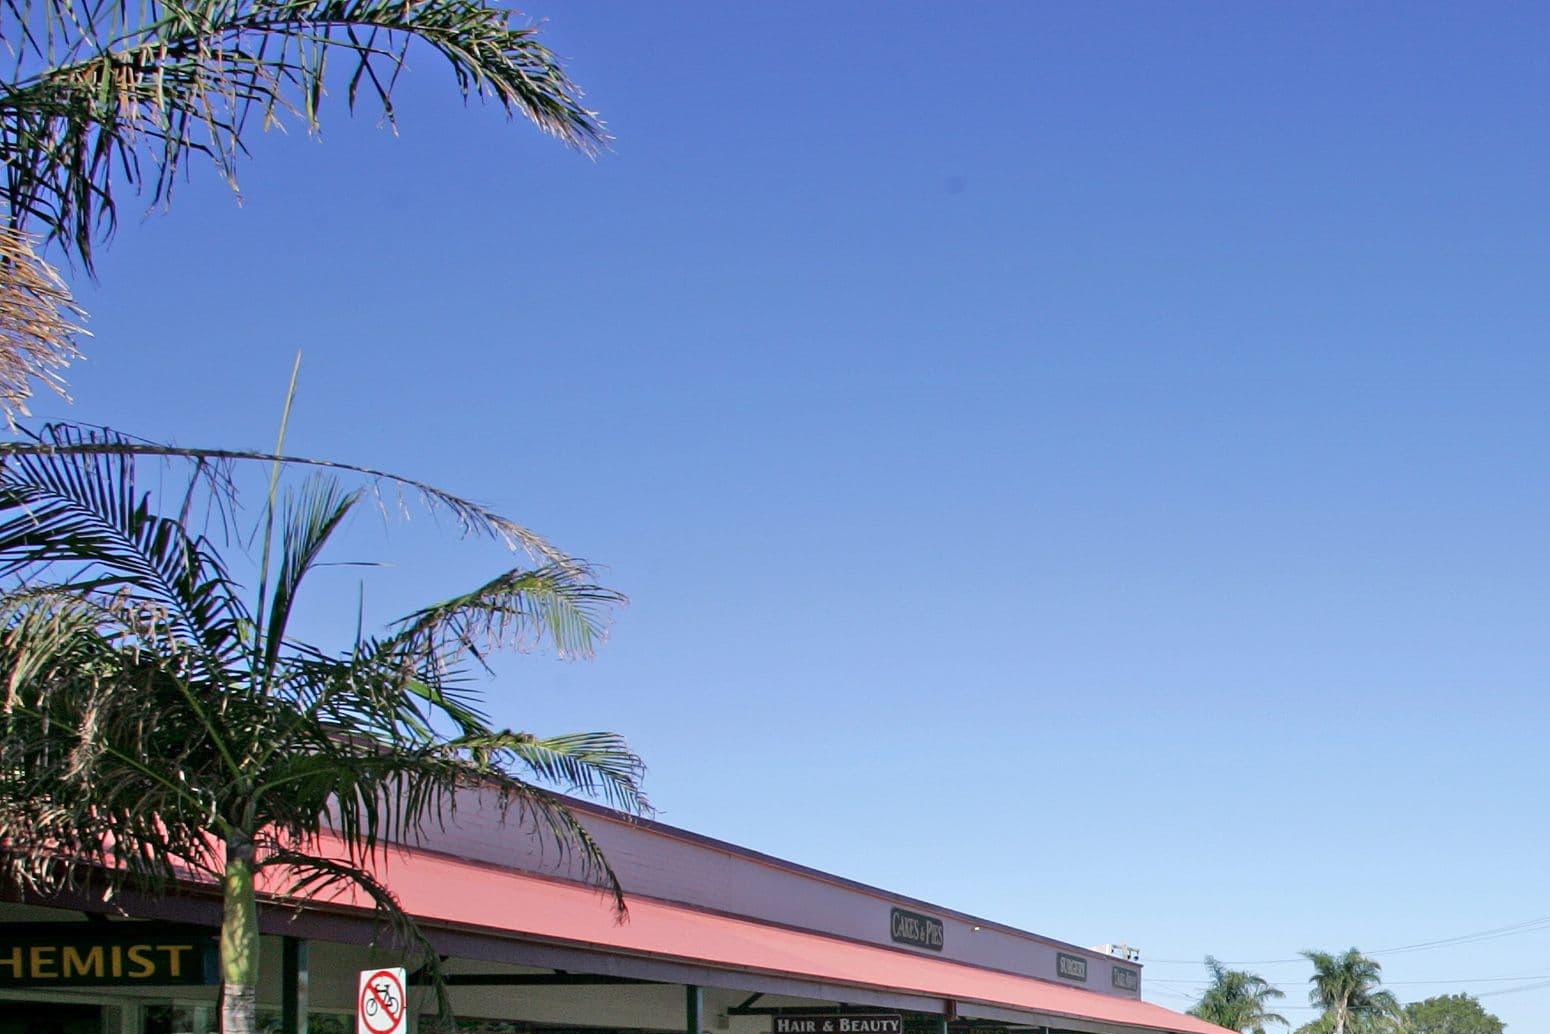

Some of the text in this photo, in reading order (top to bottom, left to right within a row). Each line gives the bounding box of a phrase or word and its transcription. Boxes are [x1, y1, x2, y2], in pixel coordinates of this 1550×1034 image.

[0, 944, 193, 979] HEMIST
[777, 1017, 900, 1033] HAIR & BEAUTY
